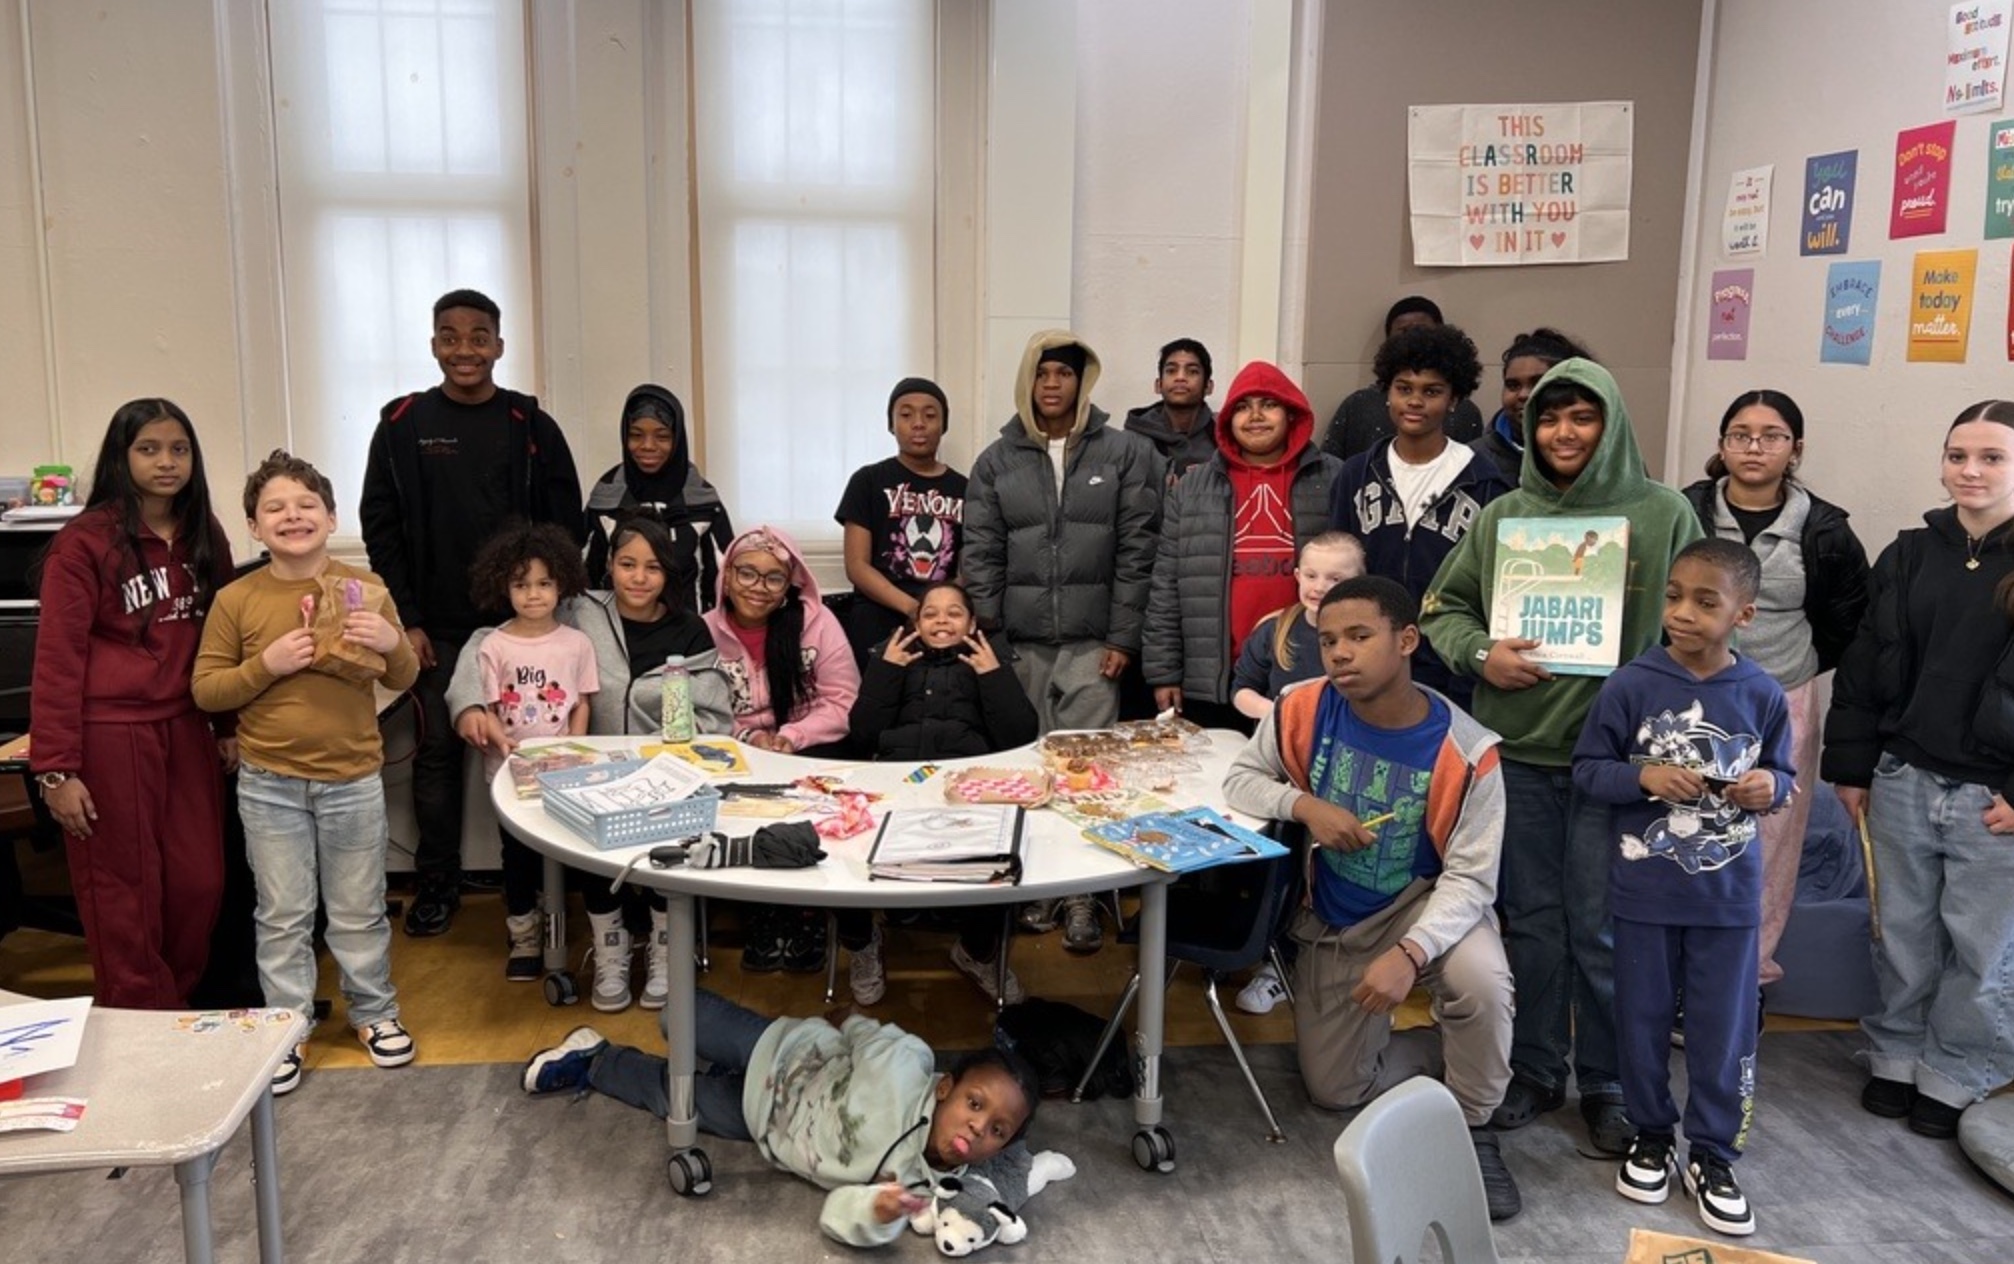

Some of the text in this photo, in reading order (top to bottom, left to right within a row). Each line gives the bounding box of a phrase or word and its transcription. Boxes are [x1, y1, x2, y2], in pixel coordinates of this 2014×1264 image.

[1946, 85, 1963, 104] No
[1498, 115, 1544, 137] THIS
[1459, 143, 1584, 167] CLASSROOM
[1467, 172, 1574, 196] IS BETTER
[1809, 185, 1846, 215] can
[1466, 201, 1576, 224] WITH YOU
[1496, 230, 1545, 252] IN IT
[1808, 222, 1839, 250] will.
[1923, 268, 1960, 285] Make
[1830, 278, 1873, 299] EMBRACE
[1836, 303, 1861, 319] every
[1919, 290, 1961, 313] today
[1912, 314, 1961, 336] matter.
[883, 484, 964, 524] VENOM
[121, 566, 171, 615] NEW
[1519, 595, 1603, 620] JABARI
[1519, 620, 1603, 646] JUMPS
[516, 665, 547, 688] Big
